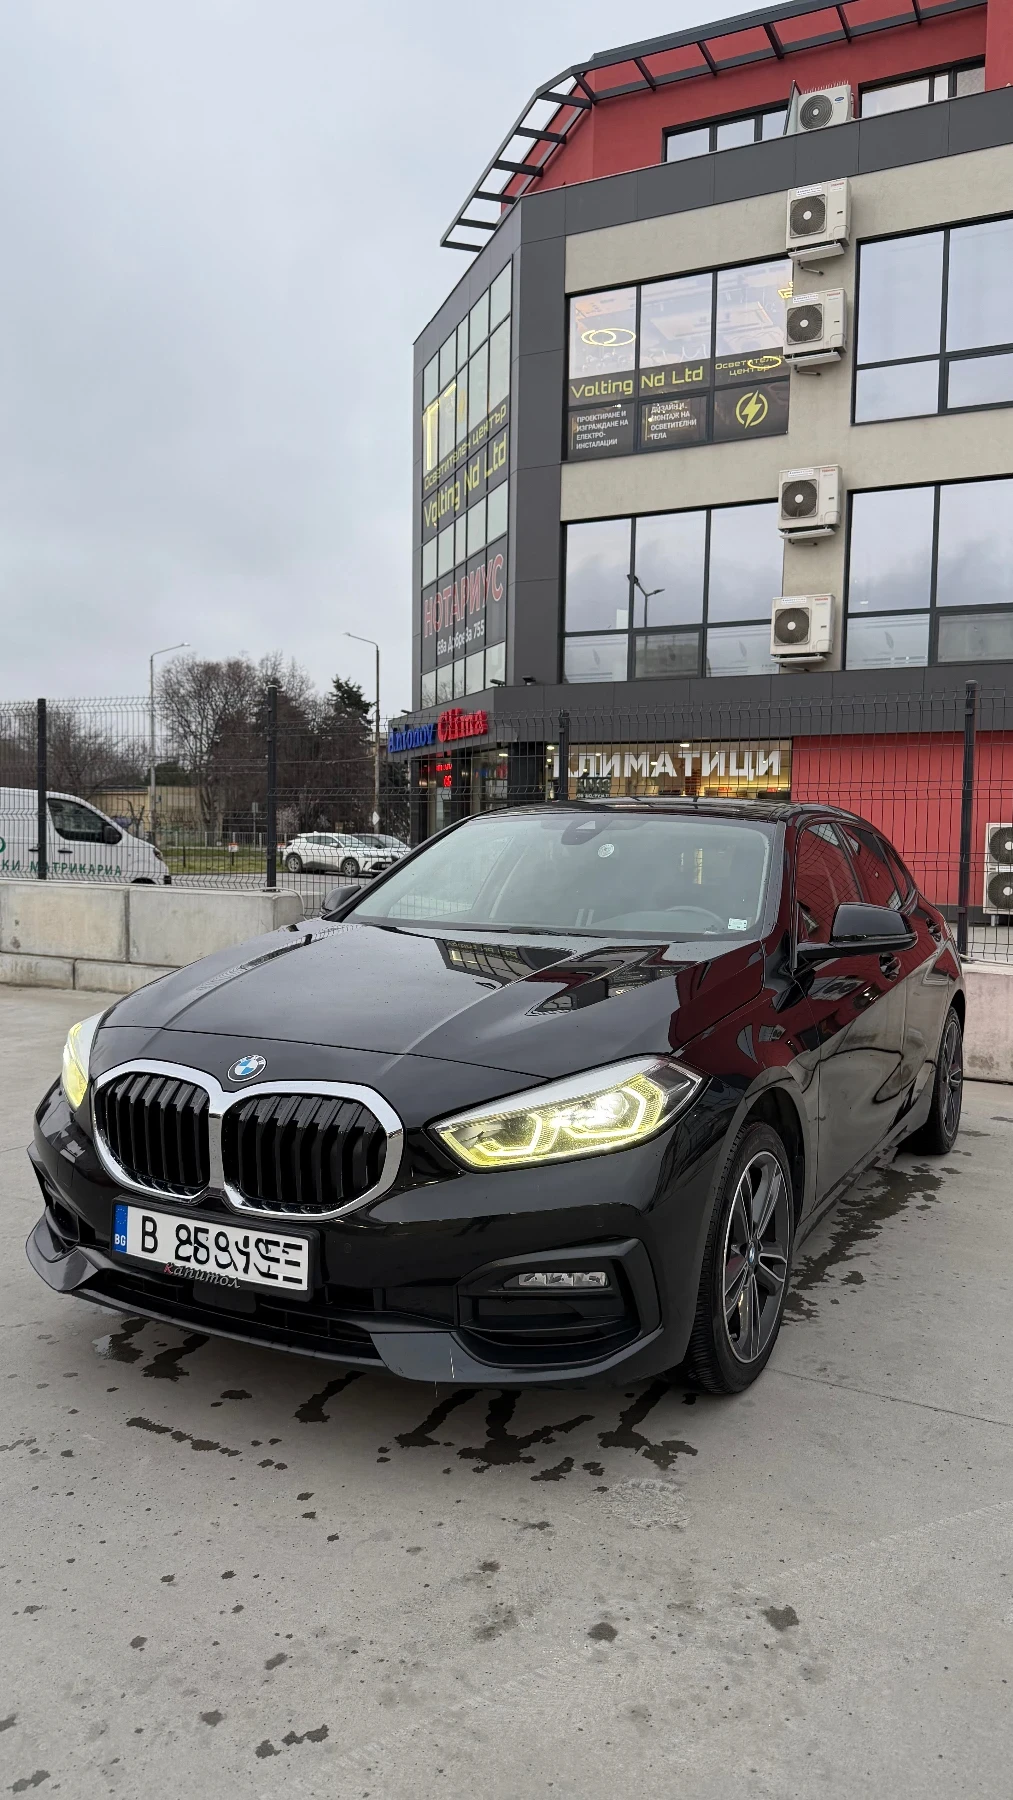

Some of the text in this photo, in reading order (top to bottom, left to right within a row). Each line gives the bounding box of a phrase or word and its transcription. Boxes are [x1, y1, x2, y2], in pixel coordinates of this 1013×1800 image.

[571, 366, 703, 398] Volting Nd Ltd
[576, 411, 620, 423] ПРОЕКТИРАНЕ
[680, 410, 690, 418] НА
[576, 418, 629, 432] ИЗГРАЖДАНЕ НА
[650, 418, 697, 431] ОСВЕТИТЕЛНИ
[651, 432, 667, 440] ТЕЛА
[576, 438, 618, 449] ИНСТАЛАЦИИ
[424, 431, 507, 527] Volting Nd Ltd
[424, 553, 504, 638] НОТАРИУС
[473, 619, 485, 639] 755
[388, 723, 436, 753] Antonov
[553, 748, 781, 781] КЛИМАТИЦИ
[114, 1233, 126, 1247] BG
